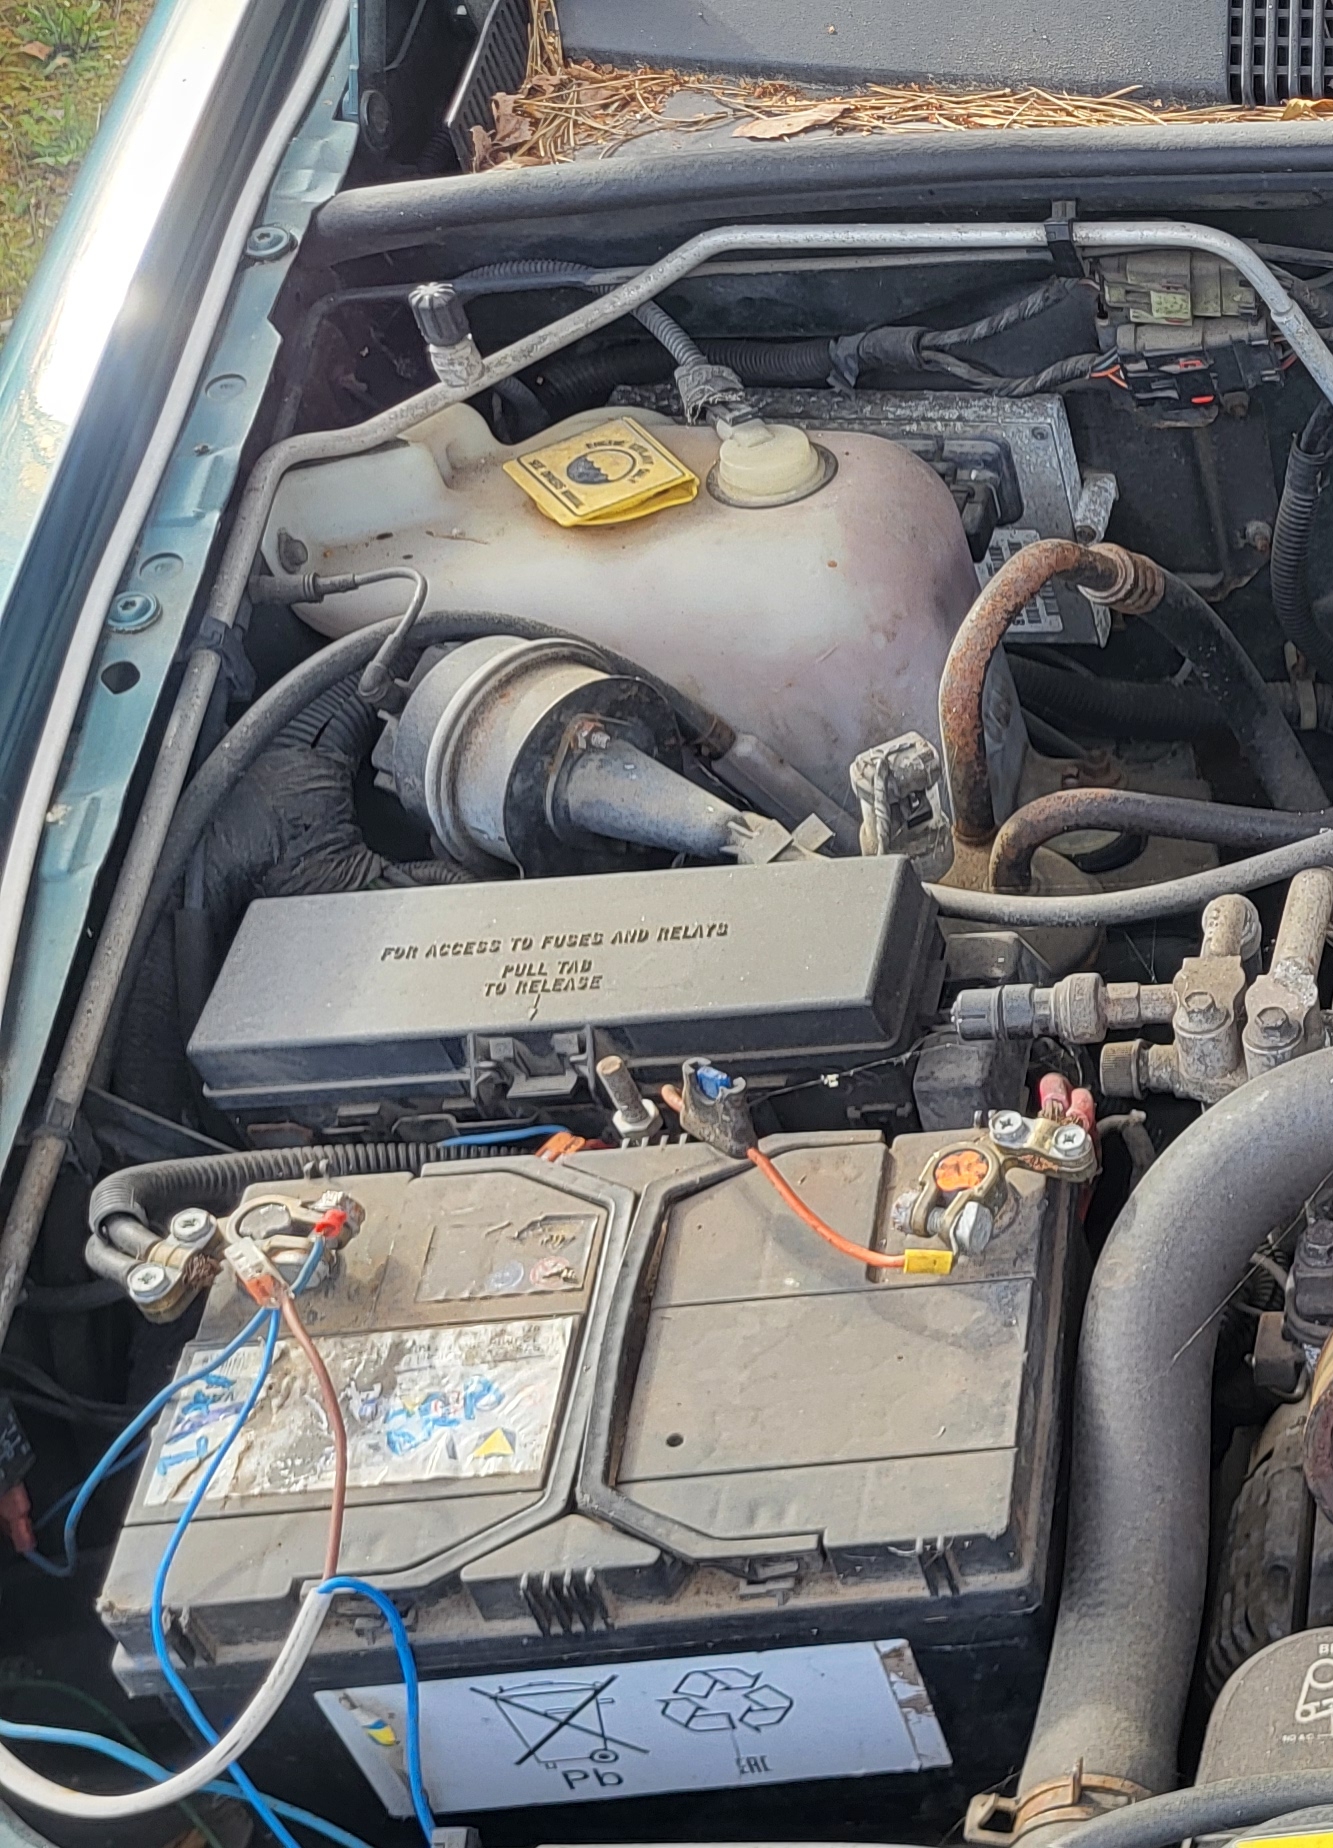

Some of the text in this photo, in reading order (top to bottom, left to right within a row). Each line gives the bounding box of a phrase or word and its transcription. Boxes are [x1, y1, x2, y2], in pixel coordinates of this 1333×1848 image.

[381, 922, 729, 961] FOR ACCESS TO FUSES AND RELAYS
[502, 959, 592, 979] PULL TAB
[484, 975, 603, 997] TO RELEASE
[561, 1767, 624, 1790] Pb
